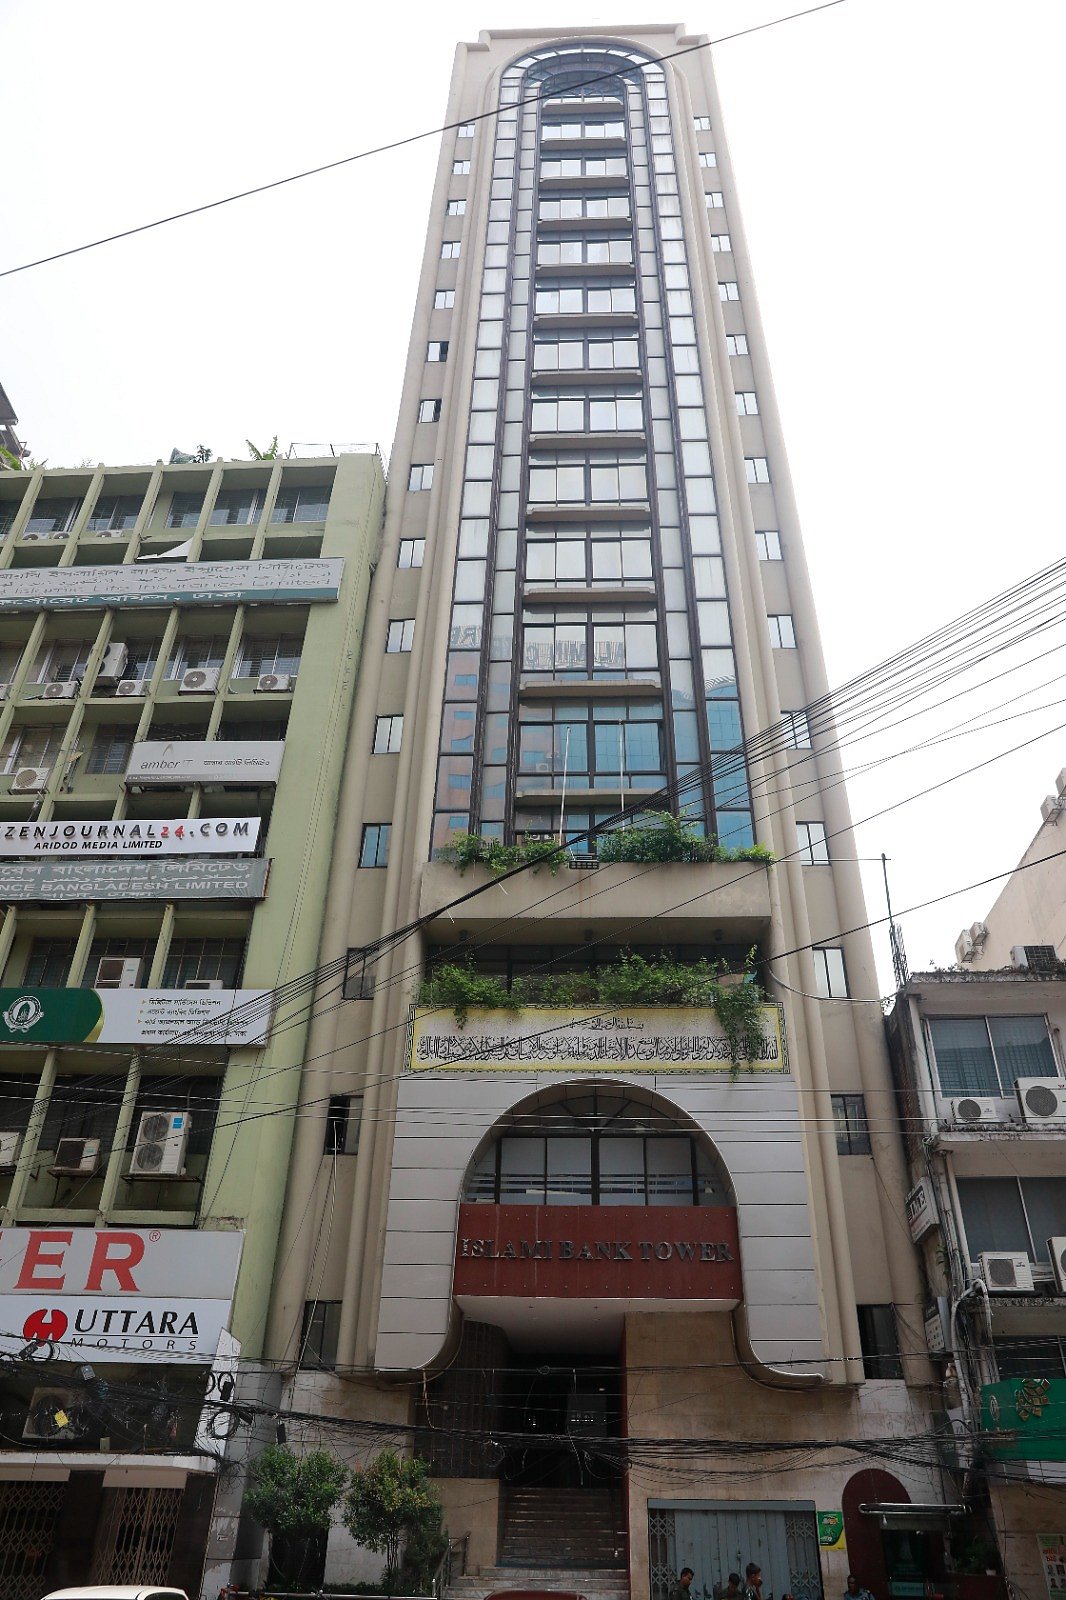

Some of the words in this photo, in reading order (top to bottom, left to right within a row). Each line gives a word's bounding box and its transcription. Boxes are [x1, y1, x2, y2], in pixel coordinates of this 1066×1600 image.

[141, 759, 181, 770] amber
[0, 822, 250, 840] ZENJOURNAL24.COM
[34, 841, 78, 850] ARIDOD
[81, 841, 119, 850] MEDIA
[122, 840, 163, 849] LIMITED
[40, 881, 169, 892] BANGLADESH
[175, 880, 249, 890] LIMITED
[460, 1238, 552, 1259] ISLAMI
[559, 1240, 633, 1260] BANK
[639, 1240, 734, 1262] TOWER
[0, 1230, 145, 1292] ER
[74, 1309, 199, 1335] UTTARA
[70, 1337, 197, 1351] MOTORS
